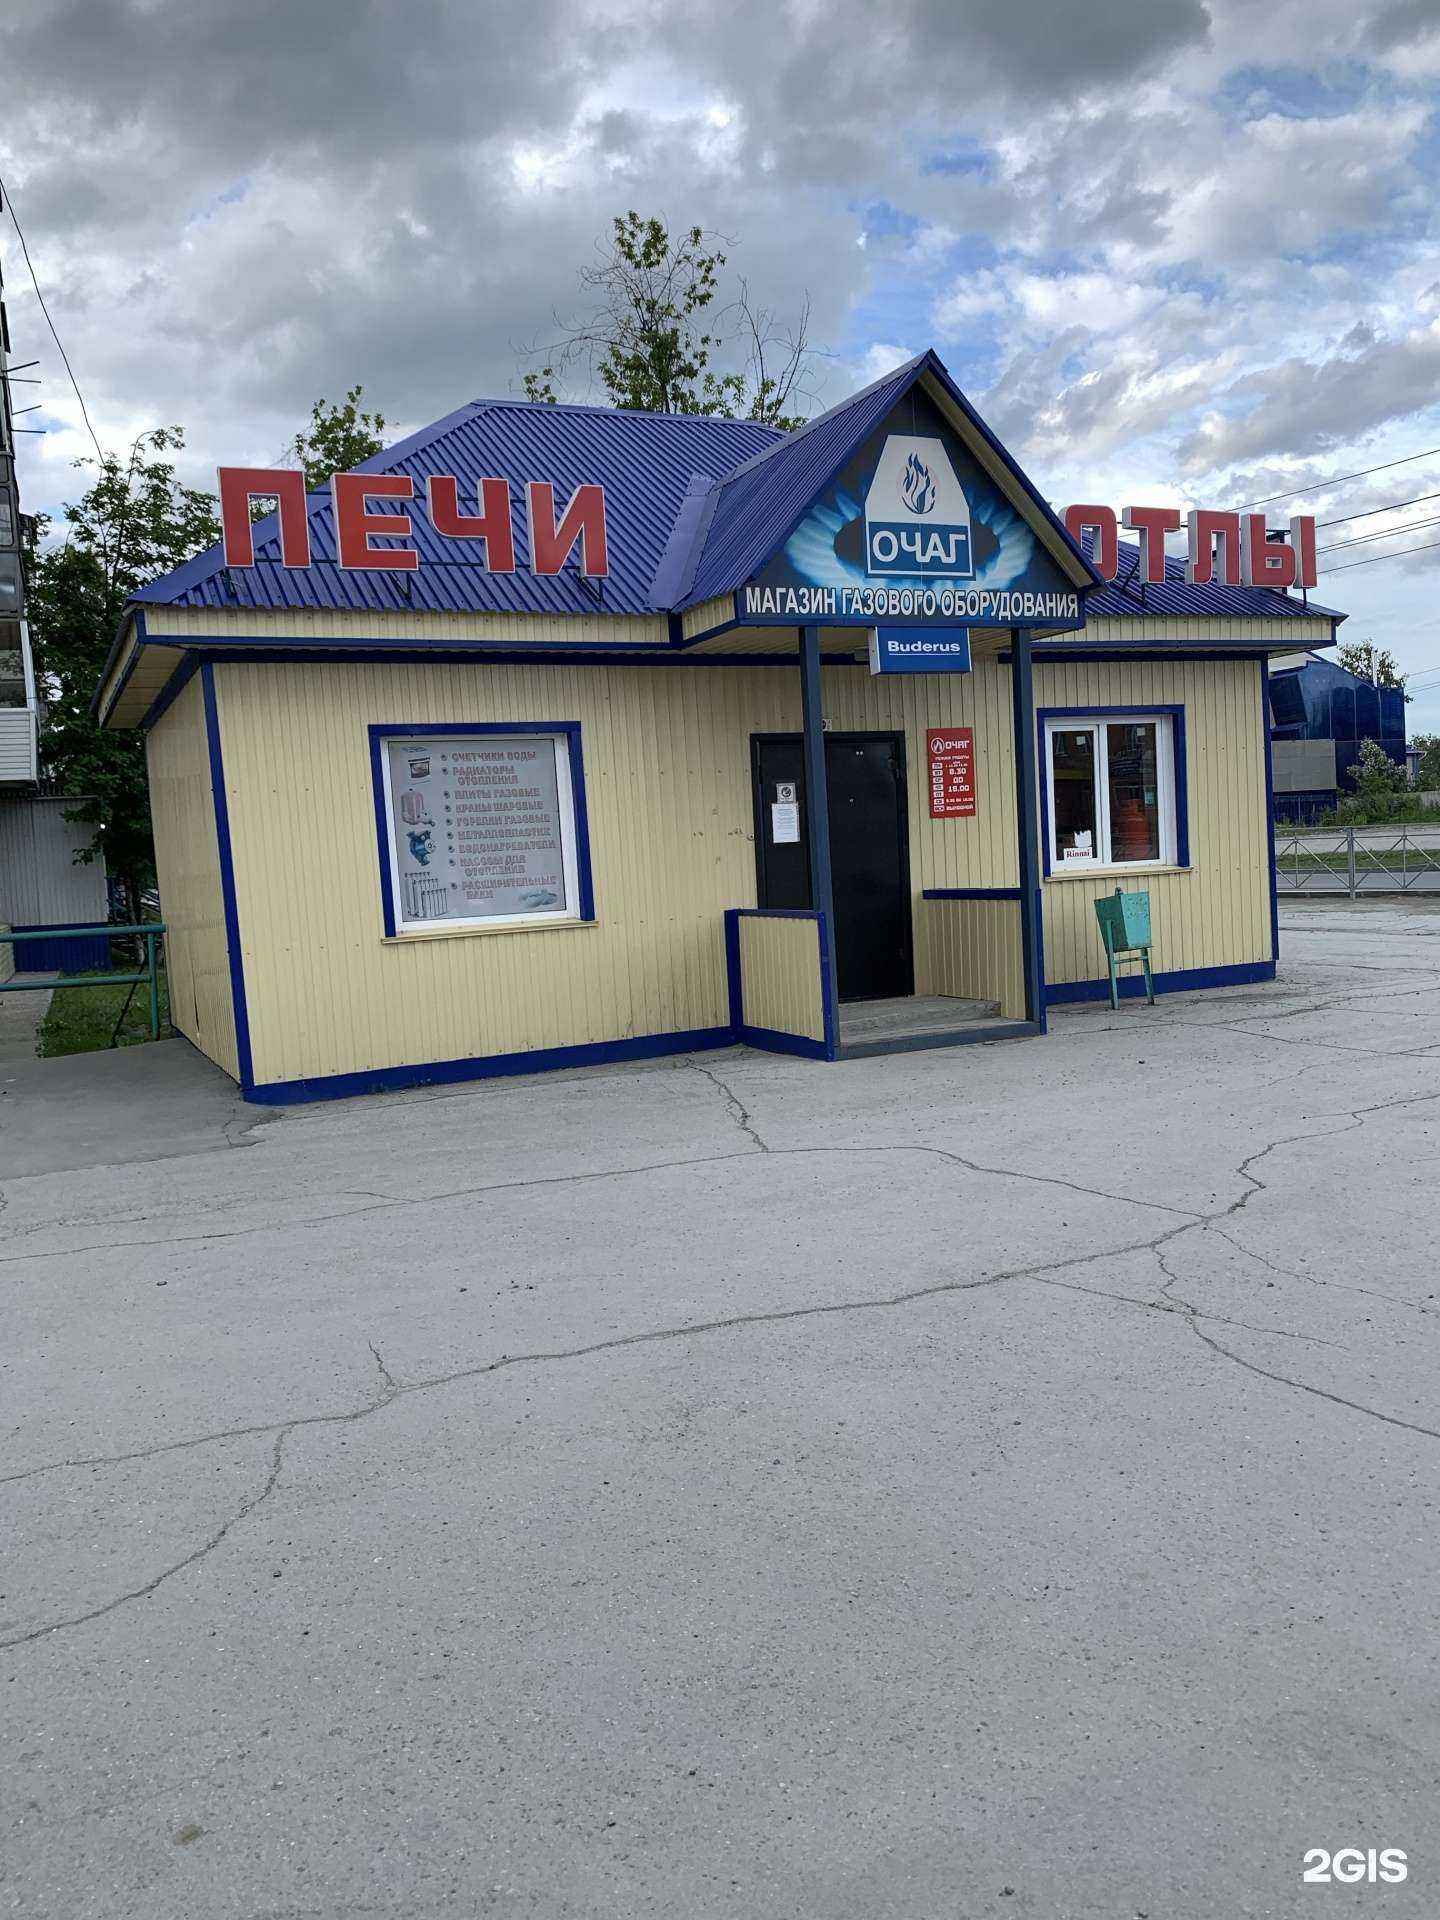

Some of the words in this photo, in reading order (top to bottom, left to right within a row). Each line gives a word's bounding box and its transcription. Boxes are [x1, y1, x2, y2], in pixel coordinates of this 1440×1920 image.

[217, 466, 609, 578] ПЕЧИ
[872, 530, 967, 564] ОЧАГ
[745, 586, 837, 615] МАГАЗИН
[841, 587, 936, 617] ГАЗОВОГО
[940, 589, 1079, 621] ОБОРУДОВАНИЯ
[887, 640, 961, 653] Buderus
[945, 740, 969, 749] ОЧАГ
